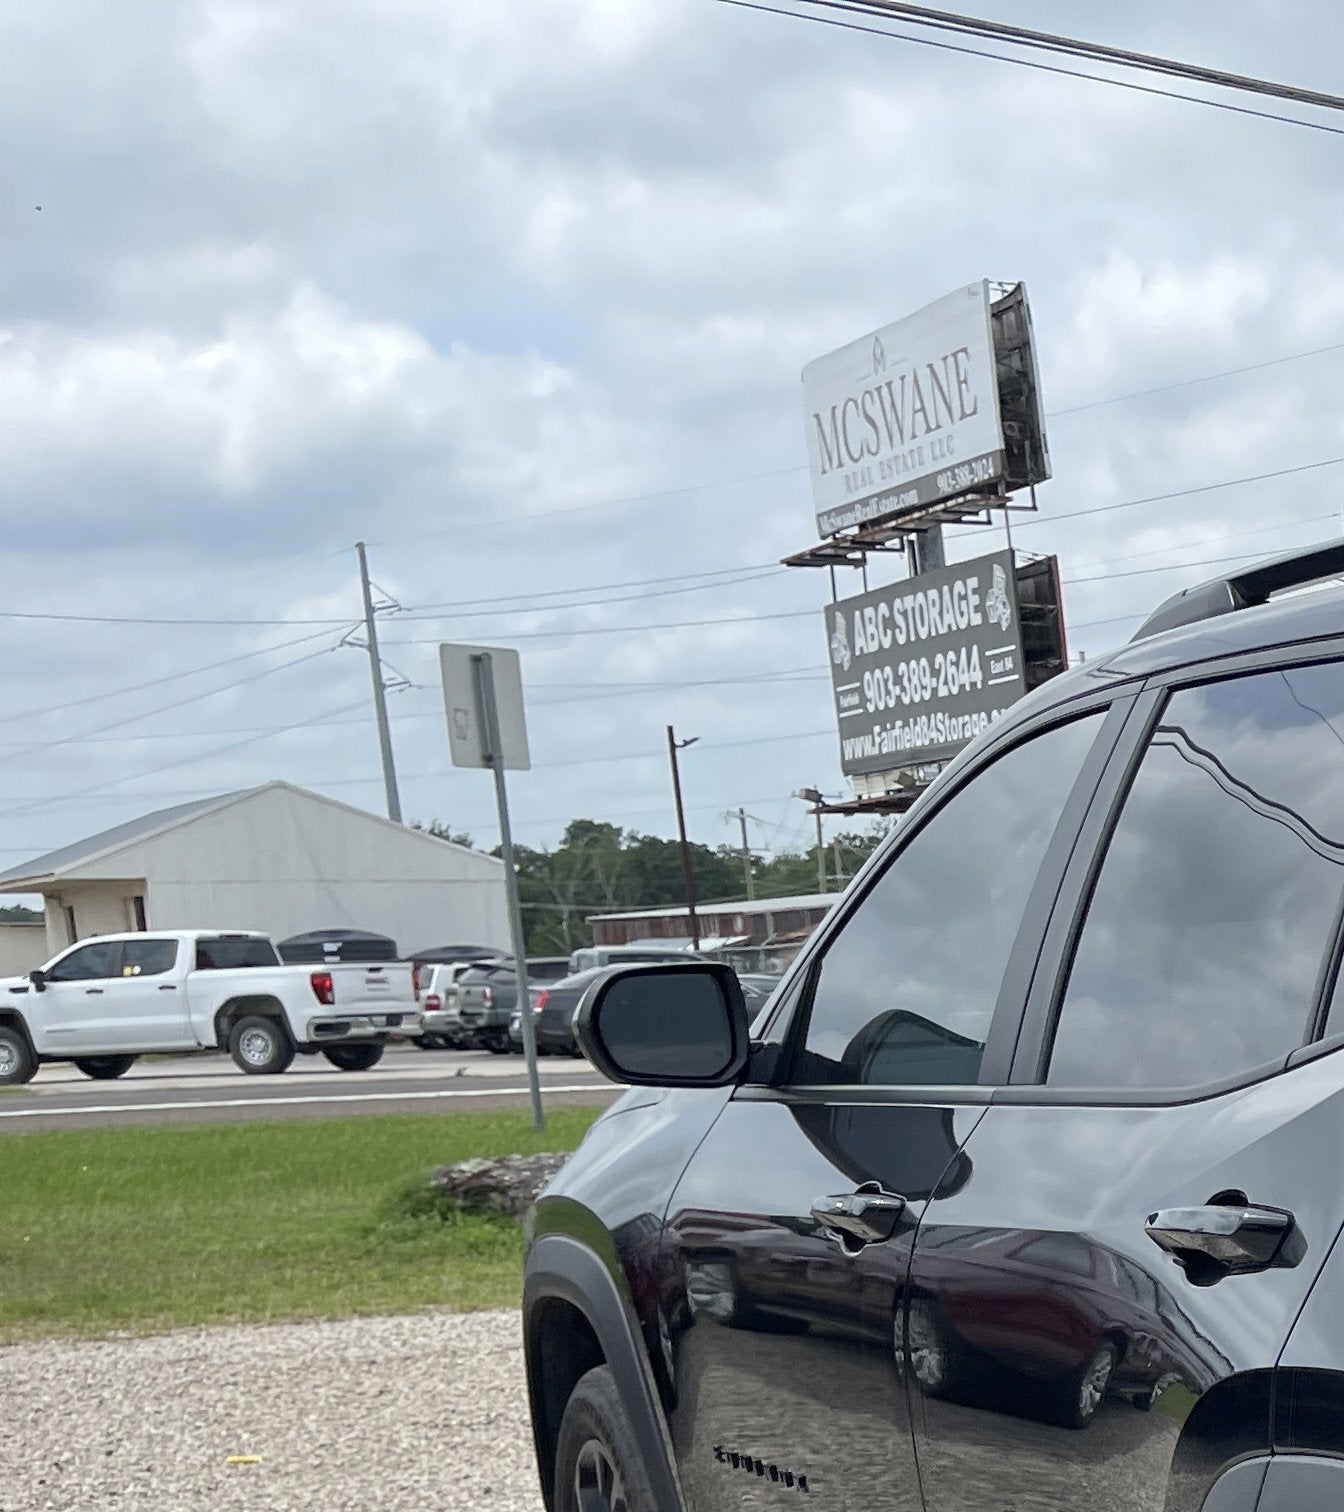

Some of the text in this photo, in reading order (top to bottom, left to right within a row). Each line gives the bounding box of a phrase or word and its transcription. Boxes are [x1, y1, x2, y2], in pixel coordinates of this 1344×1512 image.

[813, 347, 978, 476] MCSWANE
[844, 434, 955, 493] REAL ESTATE LLC
[853, 576, 983, 657] ABC STORAGE
[862, 644, 984, 713] 903-389-2644
[842, 708, 1006, 760] www.Fairfield84Storagec
